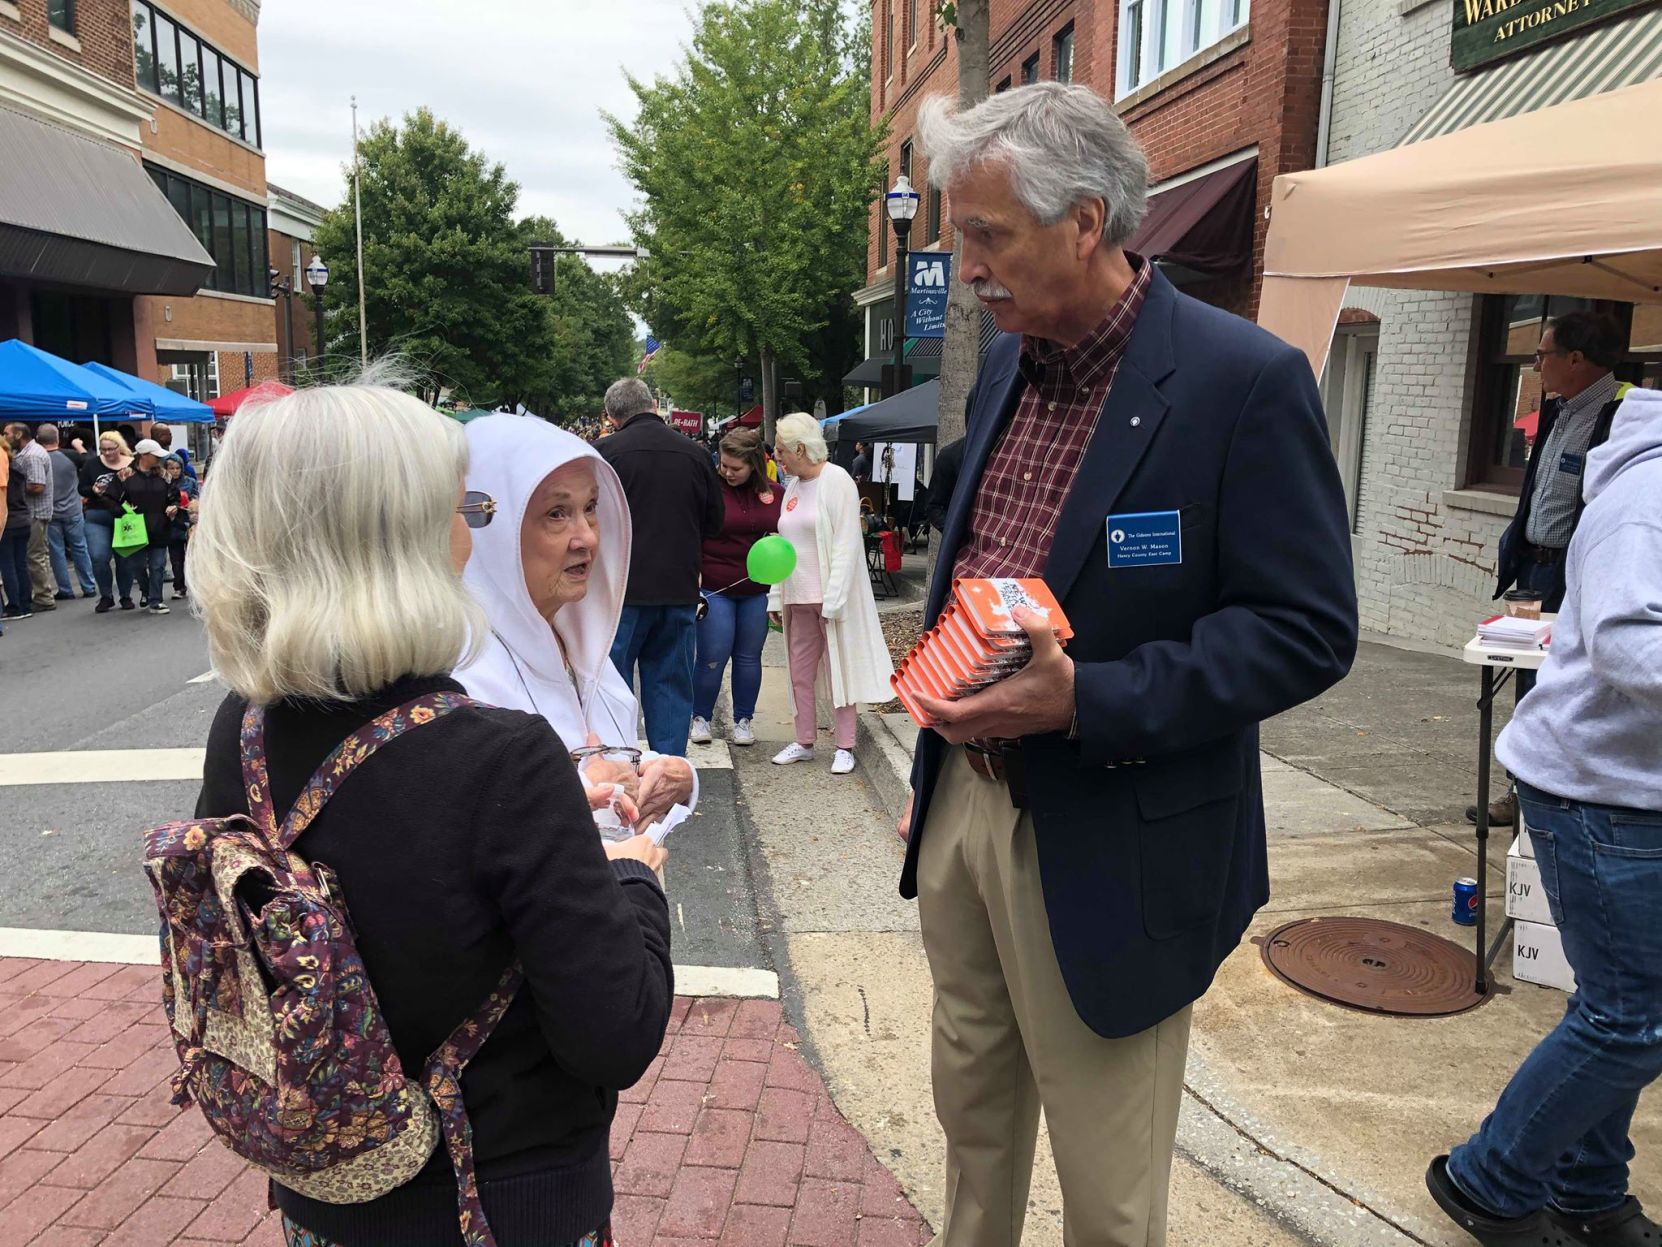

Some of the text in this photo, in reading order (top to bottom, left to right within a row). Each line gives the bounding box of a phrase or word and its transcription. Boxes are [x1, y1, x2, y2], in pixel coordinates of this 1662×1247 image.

[916, 315, 943, 325] Without
[1510, 882, 1530, 896] KJV
[1518, 944, 1539, 960] KJV
